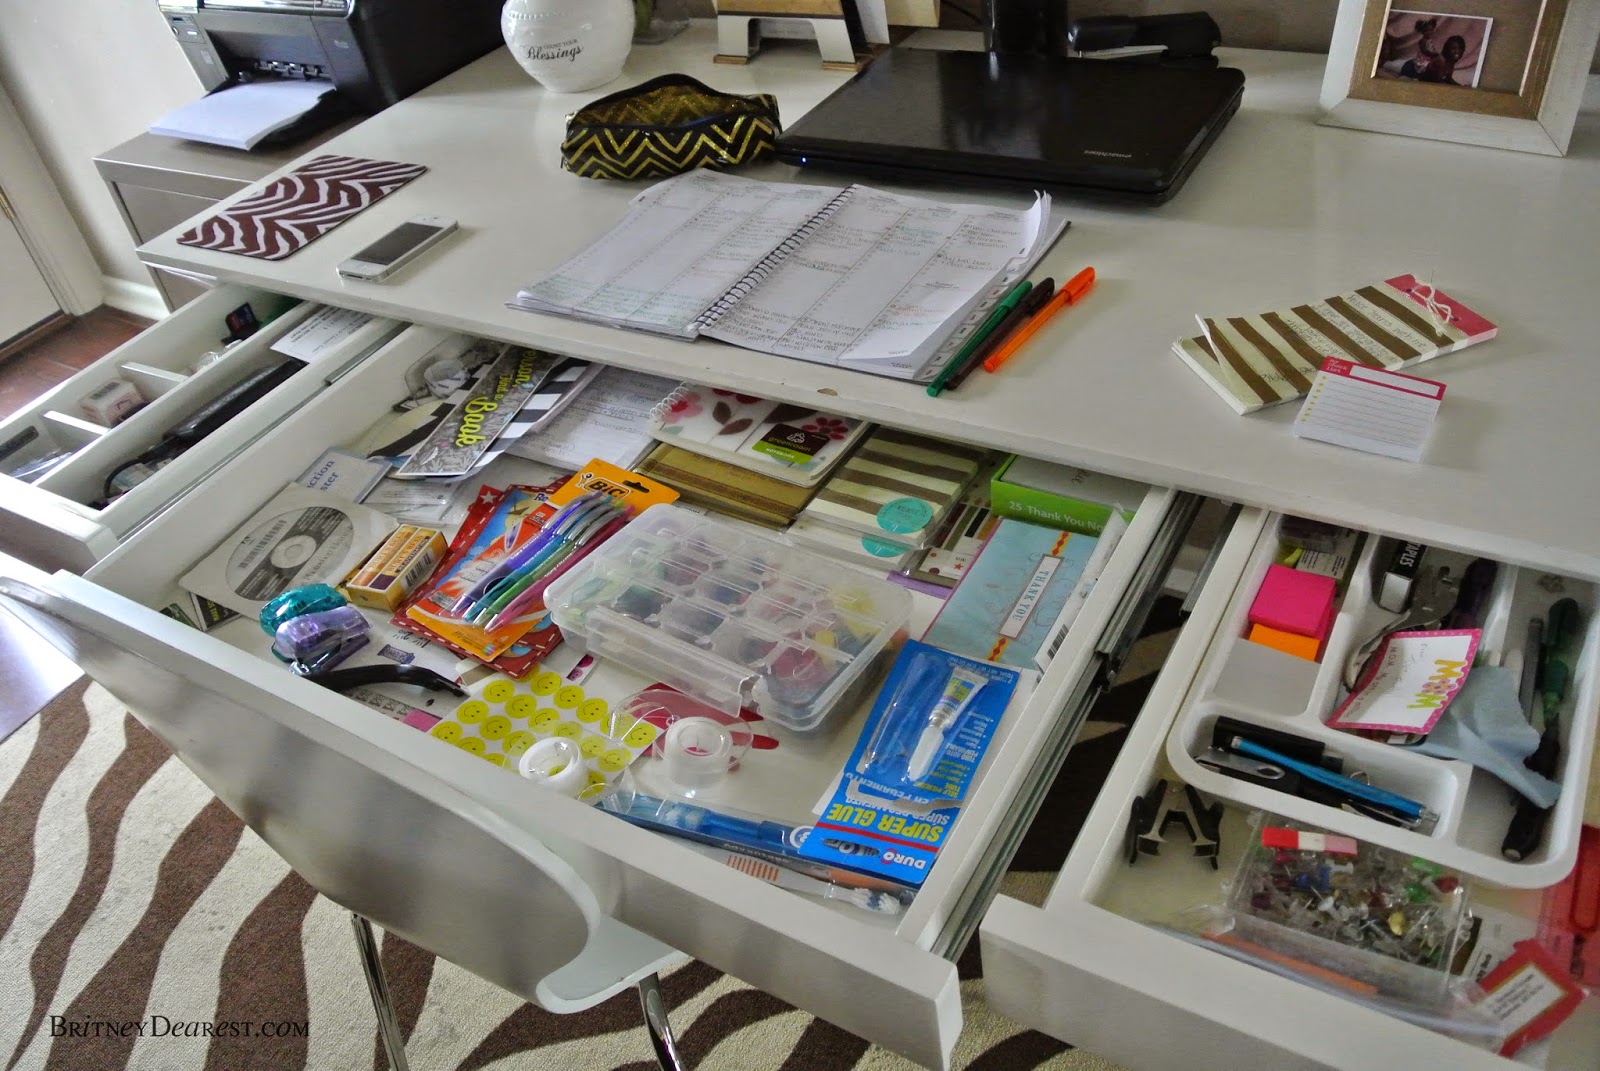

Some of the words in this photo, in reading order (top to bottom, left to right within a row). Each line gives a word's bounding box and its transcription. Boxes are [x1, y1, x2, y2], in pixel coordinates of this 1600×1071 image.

[527, 45, 584, 62] Blessings
[455, 396, 498, 447] Book
[1008, 500, 1022, 511] 25
[1027, 505, 1062, 522] Thank
[1063, 514, 1085, 527] You
[1024, 569, 1049, 601] THANK
[1012, 603, 1030, 621] YOU
[827, 804, 875, 828] GLUE
[877, 815, 943, 842] SUPER
[883, 851, 926, 869] DURO
